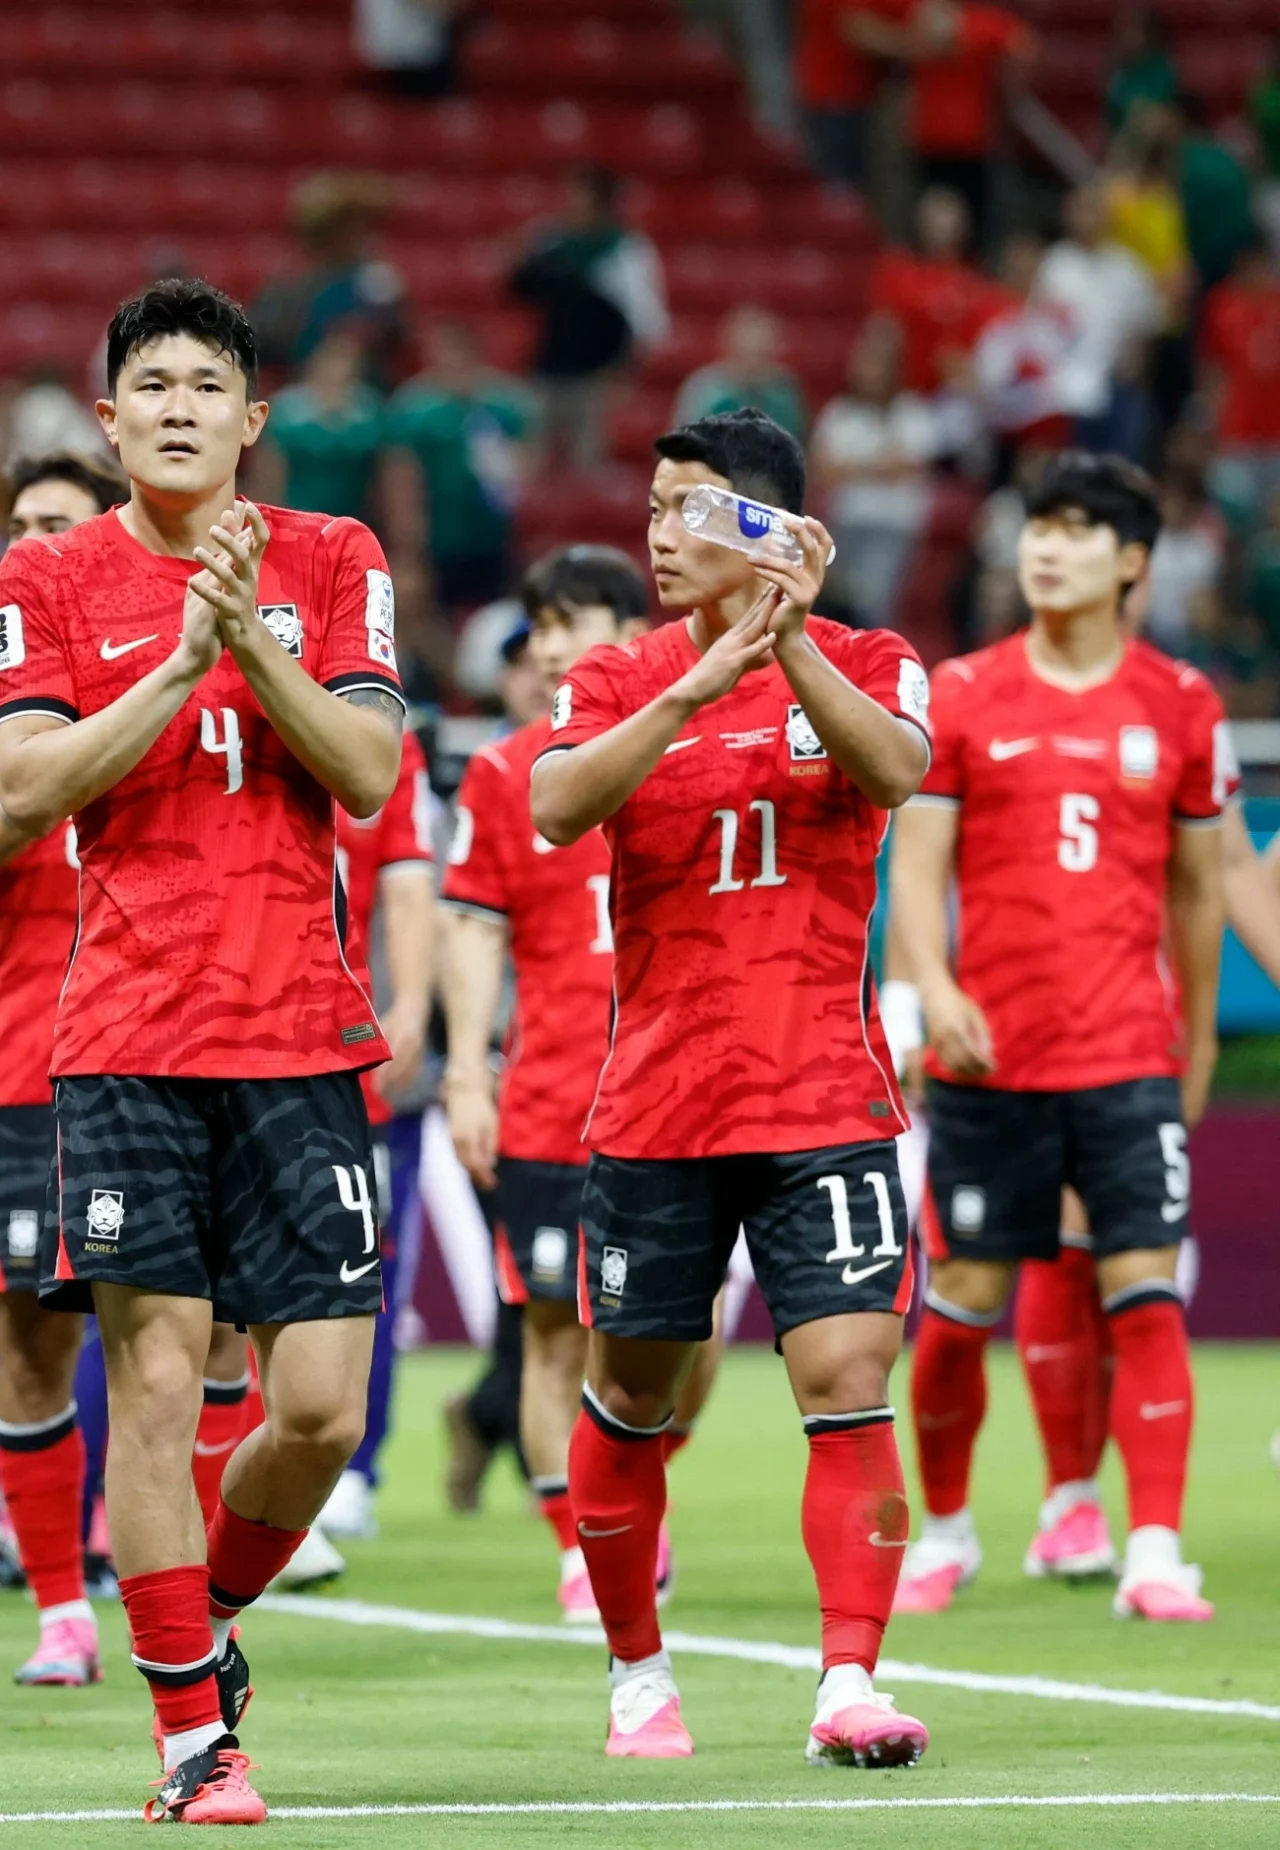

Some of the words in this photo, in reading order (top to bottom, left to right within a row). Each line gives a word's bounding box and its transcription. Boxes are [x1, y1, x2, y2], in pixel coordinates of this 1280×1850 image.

[200, 707, 243, 795] 4
[708, 799, 787, 896] 11
[1057, 792, 1100, 873] 5
[1158, 1122, 1190, 1201] 5
[84, 1241, 119, 1255] KOREA
[331, 1164, 375, 1254] 4
[816, 1171, 903, 1263] 11
